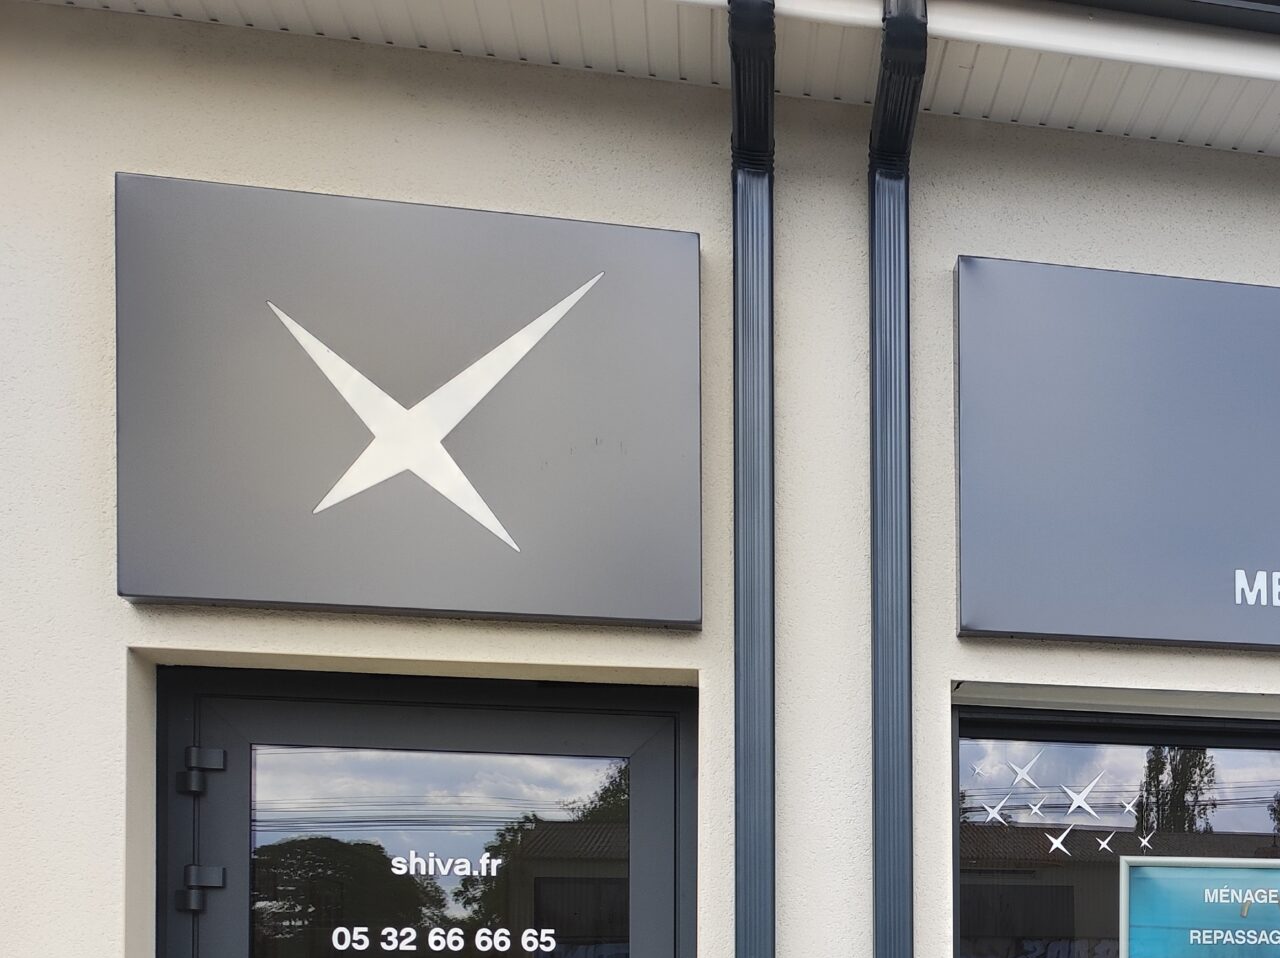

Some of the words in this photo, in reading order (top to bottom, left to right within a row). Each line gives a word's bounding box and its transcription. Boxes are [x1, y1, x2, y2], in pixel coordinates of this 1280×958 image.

[391, 851, 501, 877] shiva.fr
[1204, 885, 1279, 904] MÉNAGE
[331, 926, 369, 951] 05
[380, 927, 417, 951] 32
[427, 928, 464, 952] 66
[474, 928, 511, 952] 66
[521, 928, 557, 952] 65
